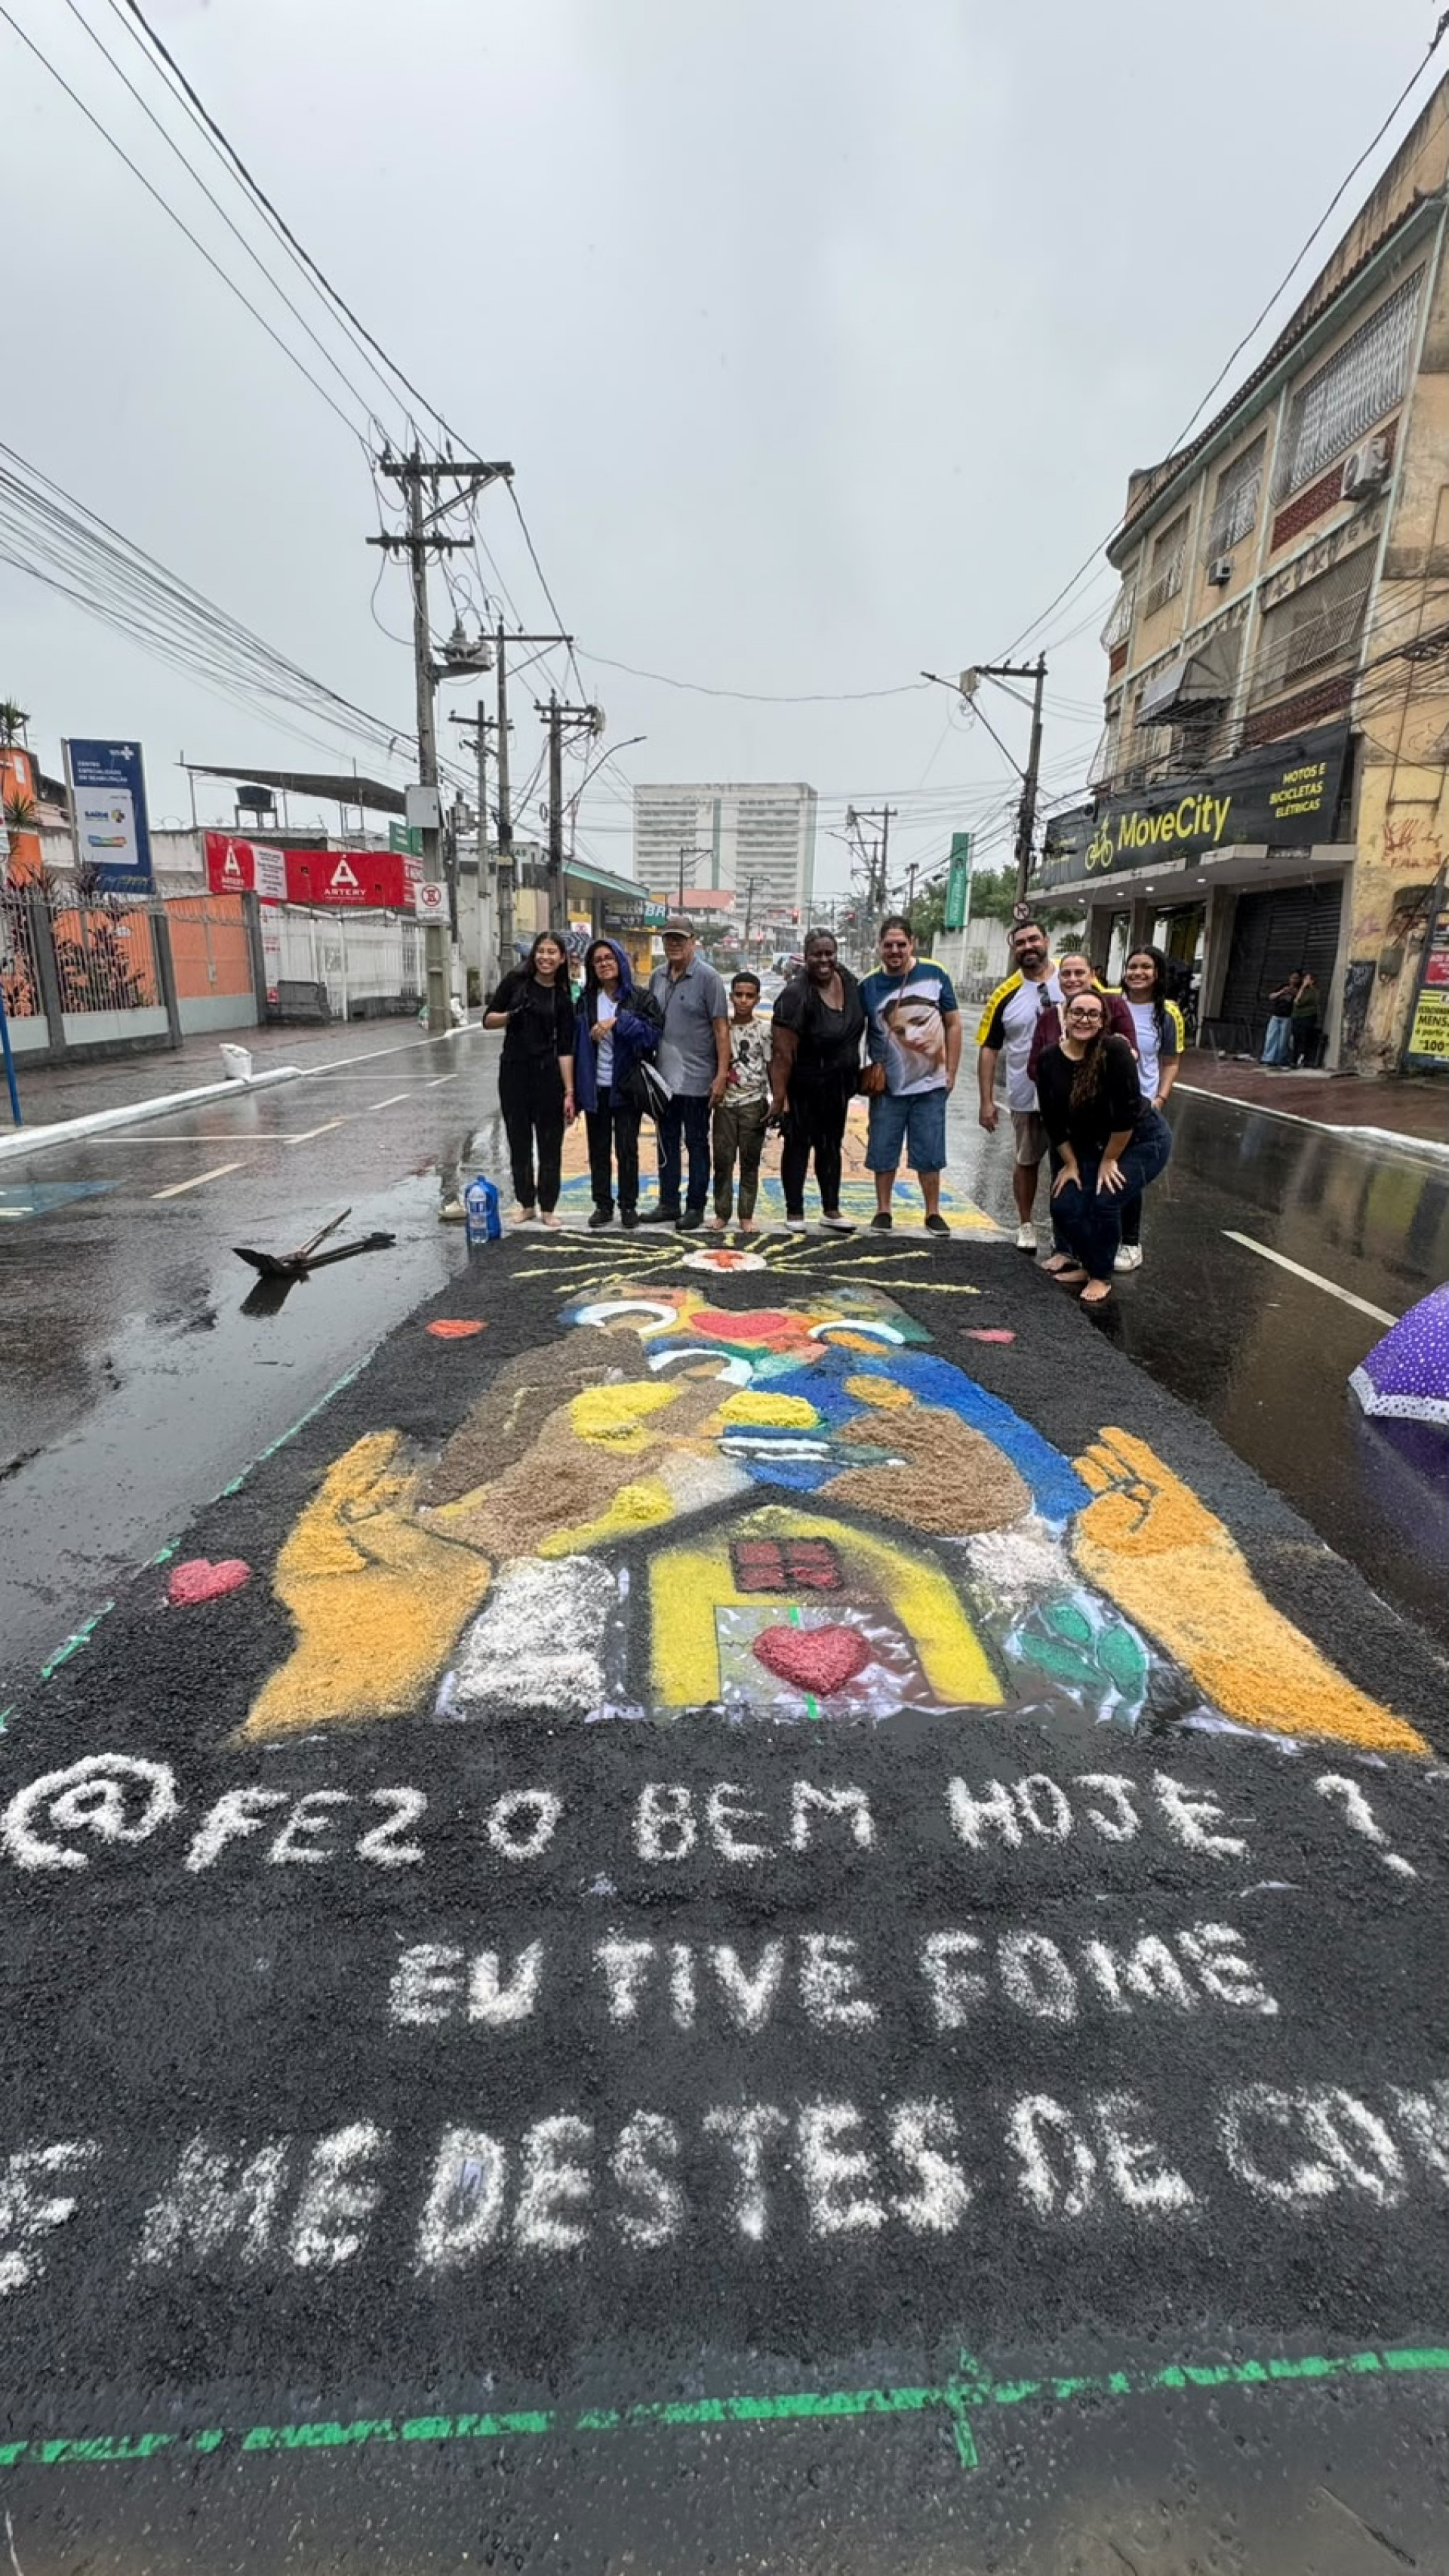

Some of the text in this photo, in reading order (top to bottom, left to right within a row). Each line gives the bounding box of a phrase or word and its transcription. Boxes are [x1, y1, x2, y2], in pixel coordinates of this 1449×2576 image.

[1283, 762, 1327, 784] MOTOS E
[1269, 780, 1324, 805] BICICLETAS
[1275, 799, 1321, 818] ELÉTRICAS
[1117, 793, 1232, 851] MoveCity
[325, 888, 367, 896] ARTERY
[645, 903, 666, 916] BR
[1418, 1015, 1449, 1027] MENS
[486, 1787, 562, 1860] O
[634, 1780, 875, 1864] BEM
[945, 1770, 1251, 1860] HOJE
[387, 1921, 1279, 2033] EU TIVE FOME
